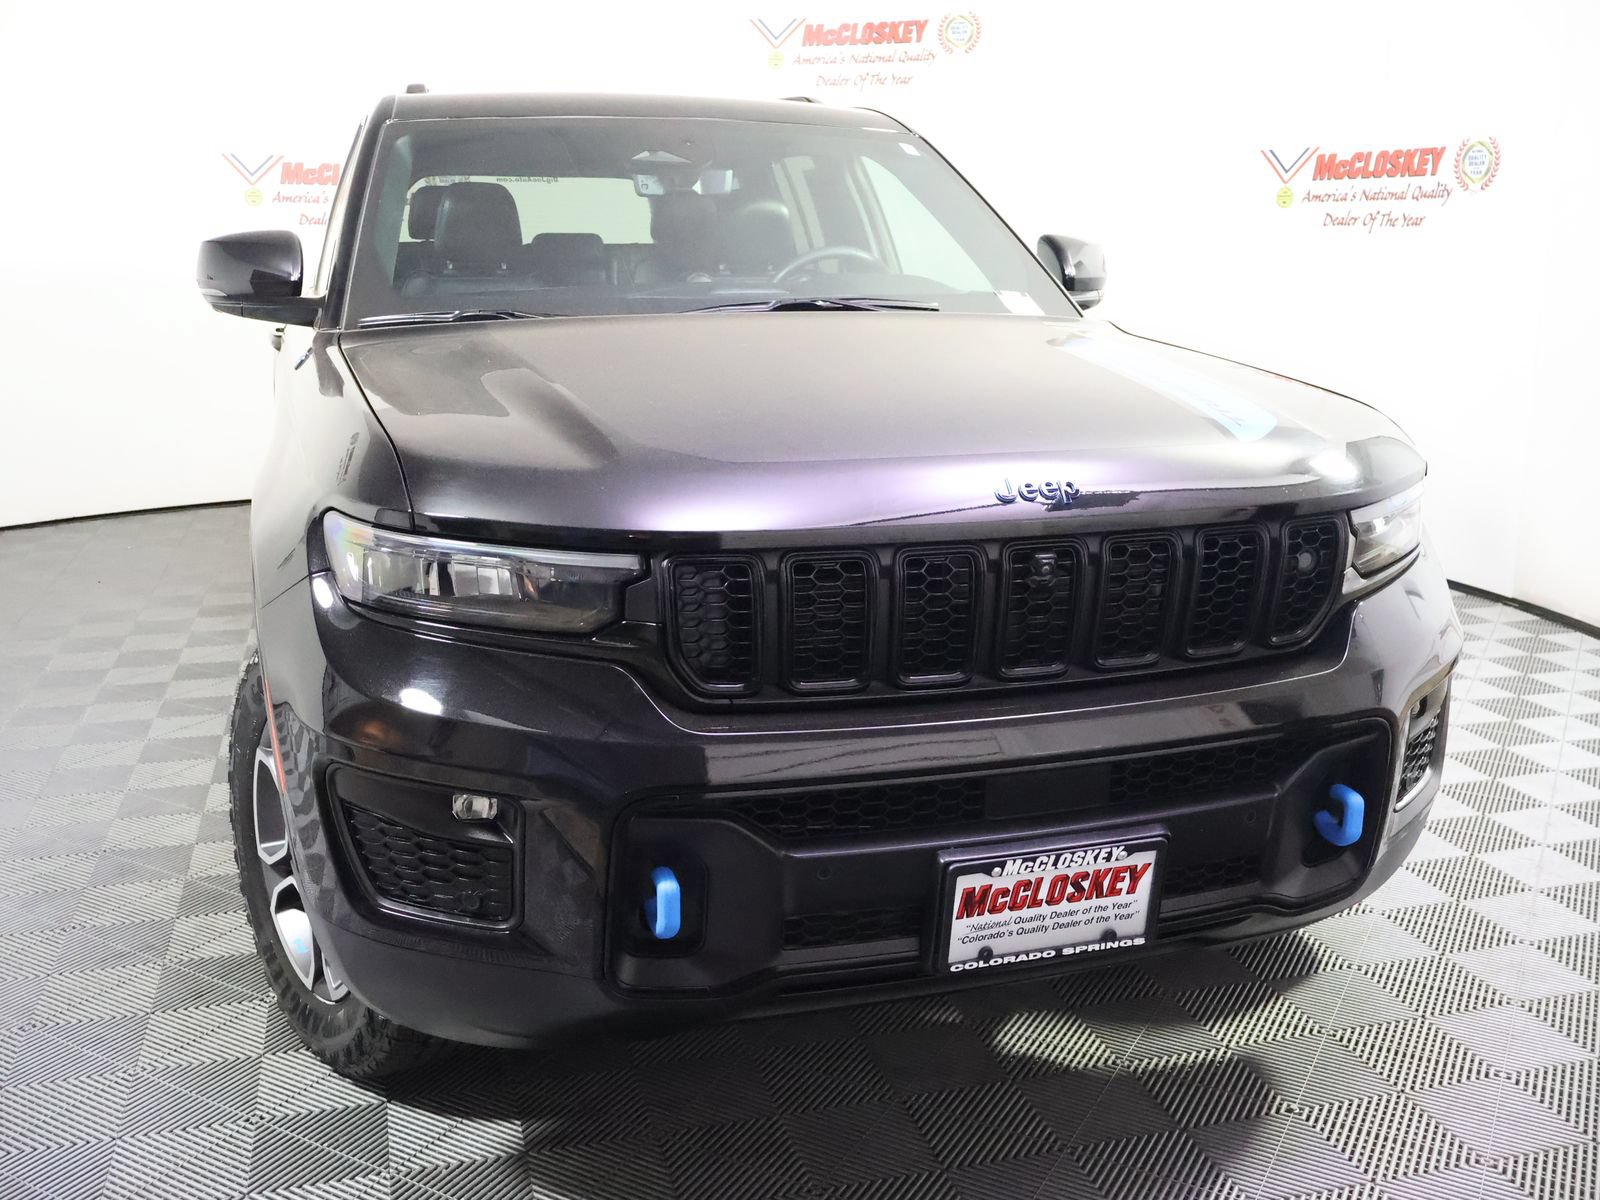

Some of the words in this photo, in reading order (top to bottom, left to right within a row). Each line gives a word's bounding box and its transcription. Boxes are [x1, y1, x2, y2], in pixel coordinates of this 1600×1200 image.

[802, 19, 930, 47] McCLOSKEY
[793, 51, 846, 66] America's
[849, 49, 896, 65] National
[898, 48, 938, 66] Quality
[816, 73, 850, 88] Dealer
[853, 72, 870, 91] Of
[870, 73, 887, 86] The
[891, 72, 914, 86] Year
[1311, 145, 1447, 181] McCLOSKEY
[271, 190, 329, 204] America's
[1301, 185, 1357, 204] America's
[1360, 183, 1409, 203] National
[1412, 182, 1454, 206] Quality
[1323, 210, 1361, 227] Dealer
[1362, 210, 1381, 234] Of
[1380, 213, 1398, 227] The
[1402, 213, 1426, 227] Year
[994, 477, 1081, 504] Jeep
[1001, 845, 1126, 876] McCLOSKEY
[955, 862, 1153, 920] McCLOSKEY
[1013, 911, 1048, 926] Quality
[1049, 907, 1080, 919] Dealer
[1081, 905, 1093, 914] of
[1093, 903, 1109, 913] the
[1016, 924, 1050, 938] Quality
[1051, 918, 1081, 931] Dealer
[1084, 916, 1095, 926] of
[1095, 914, 1111, 924] the
[950, 949, 1057, 972] COLORADO
[1061, 937, 1146, 956] SPRINGS
